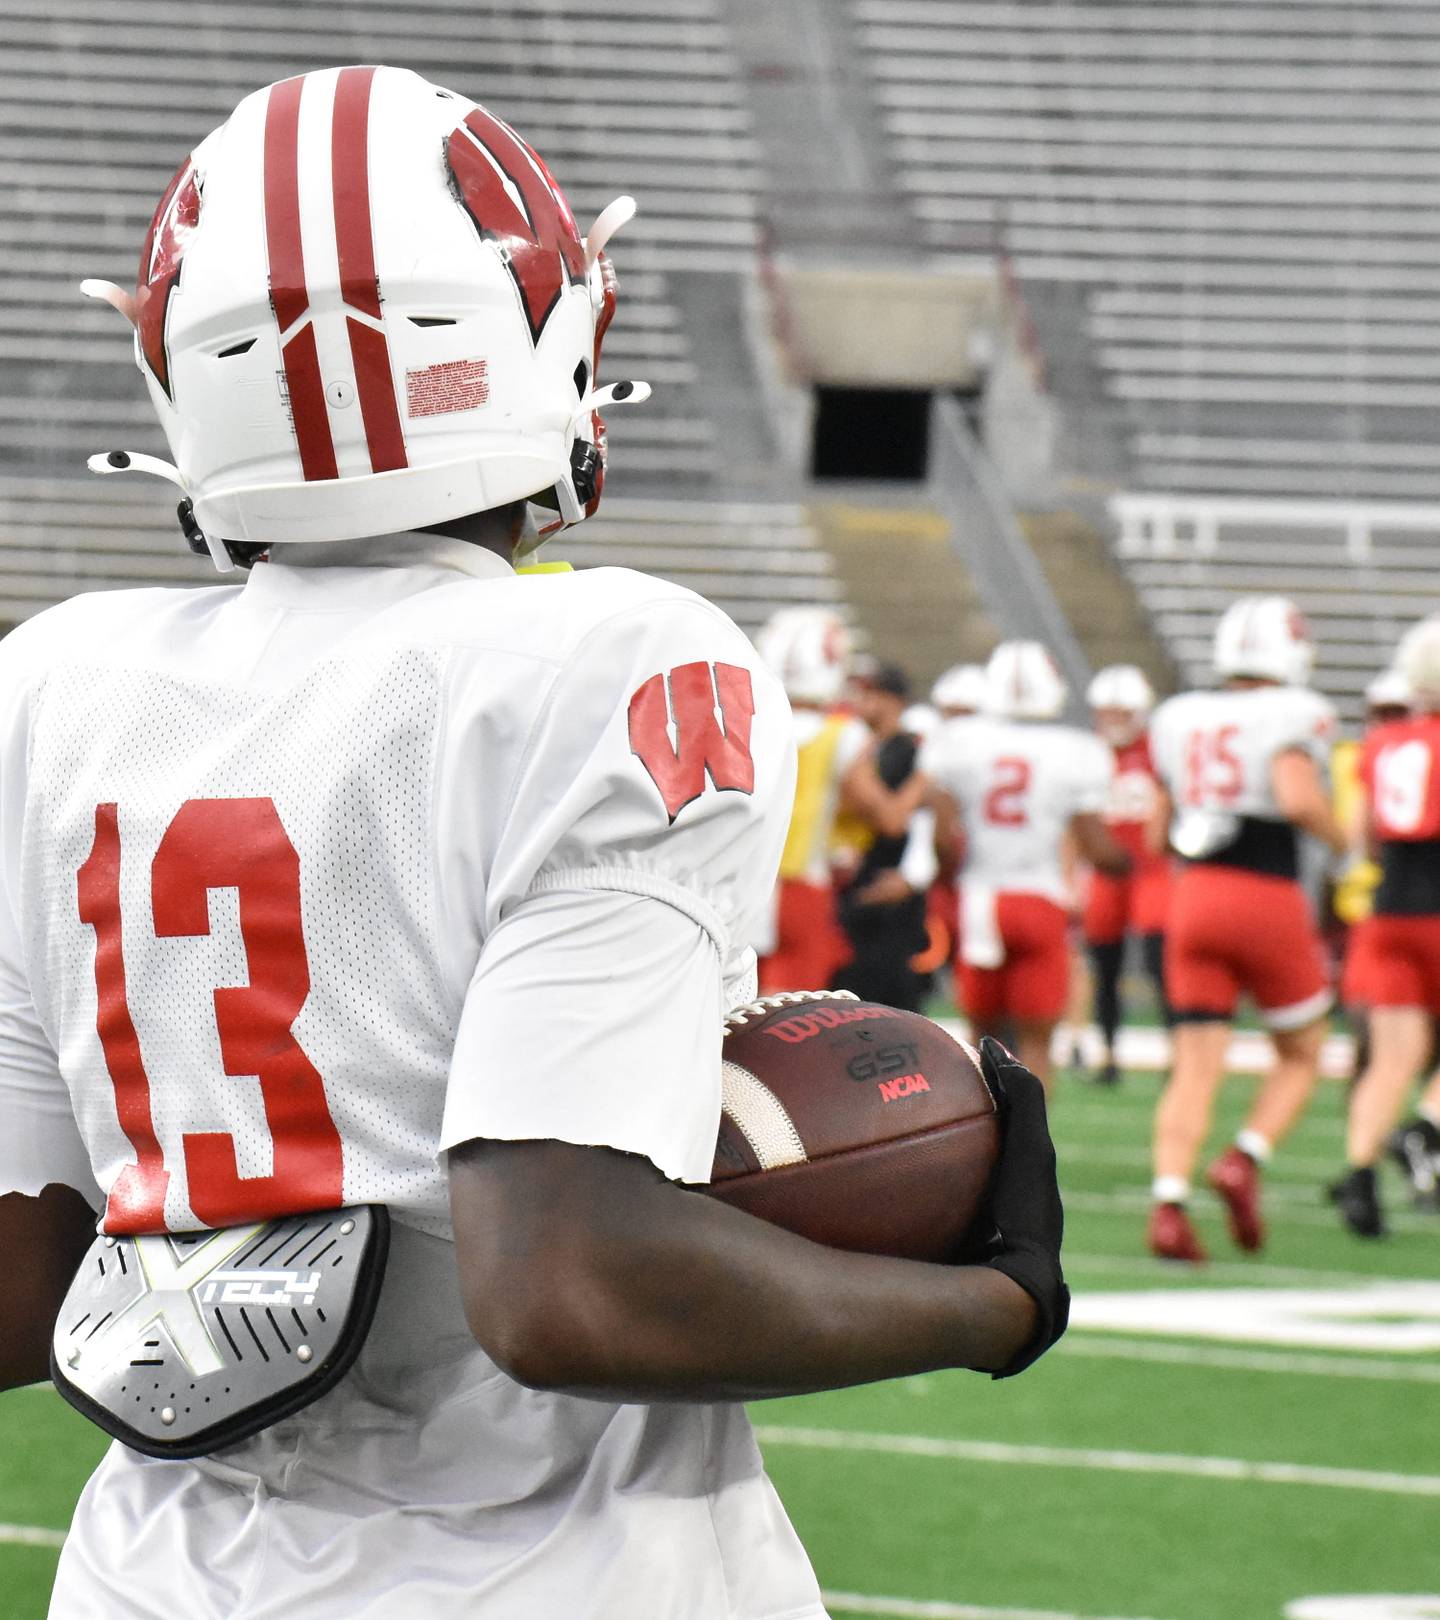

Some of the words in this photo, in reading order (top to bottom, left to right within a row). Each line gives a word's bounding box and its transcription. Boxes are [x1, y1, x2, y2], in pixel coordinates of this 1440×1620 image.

[428, 360, 468, 370] WARNING
[627, 661, 755, 827] W
[983, 756, 1033, 828] 2
[77, 797, 344, 1235] 13
[763, 1007, 904, 1043] Wilson
[846, 1042, 919, 1082] GST
[878, 1072, 930, 1104] NCAA
